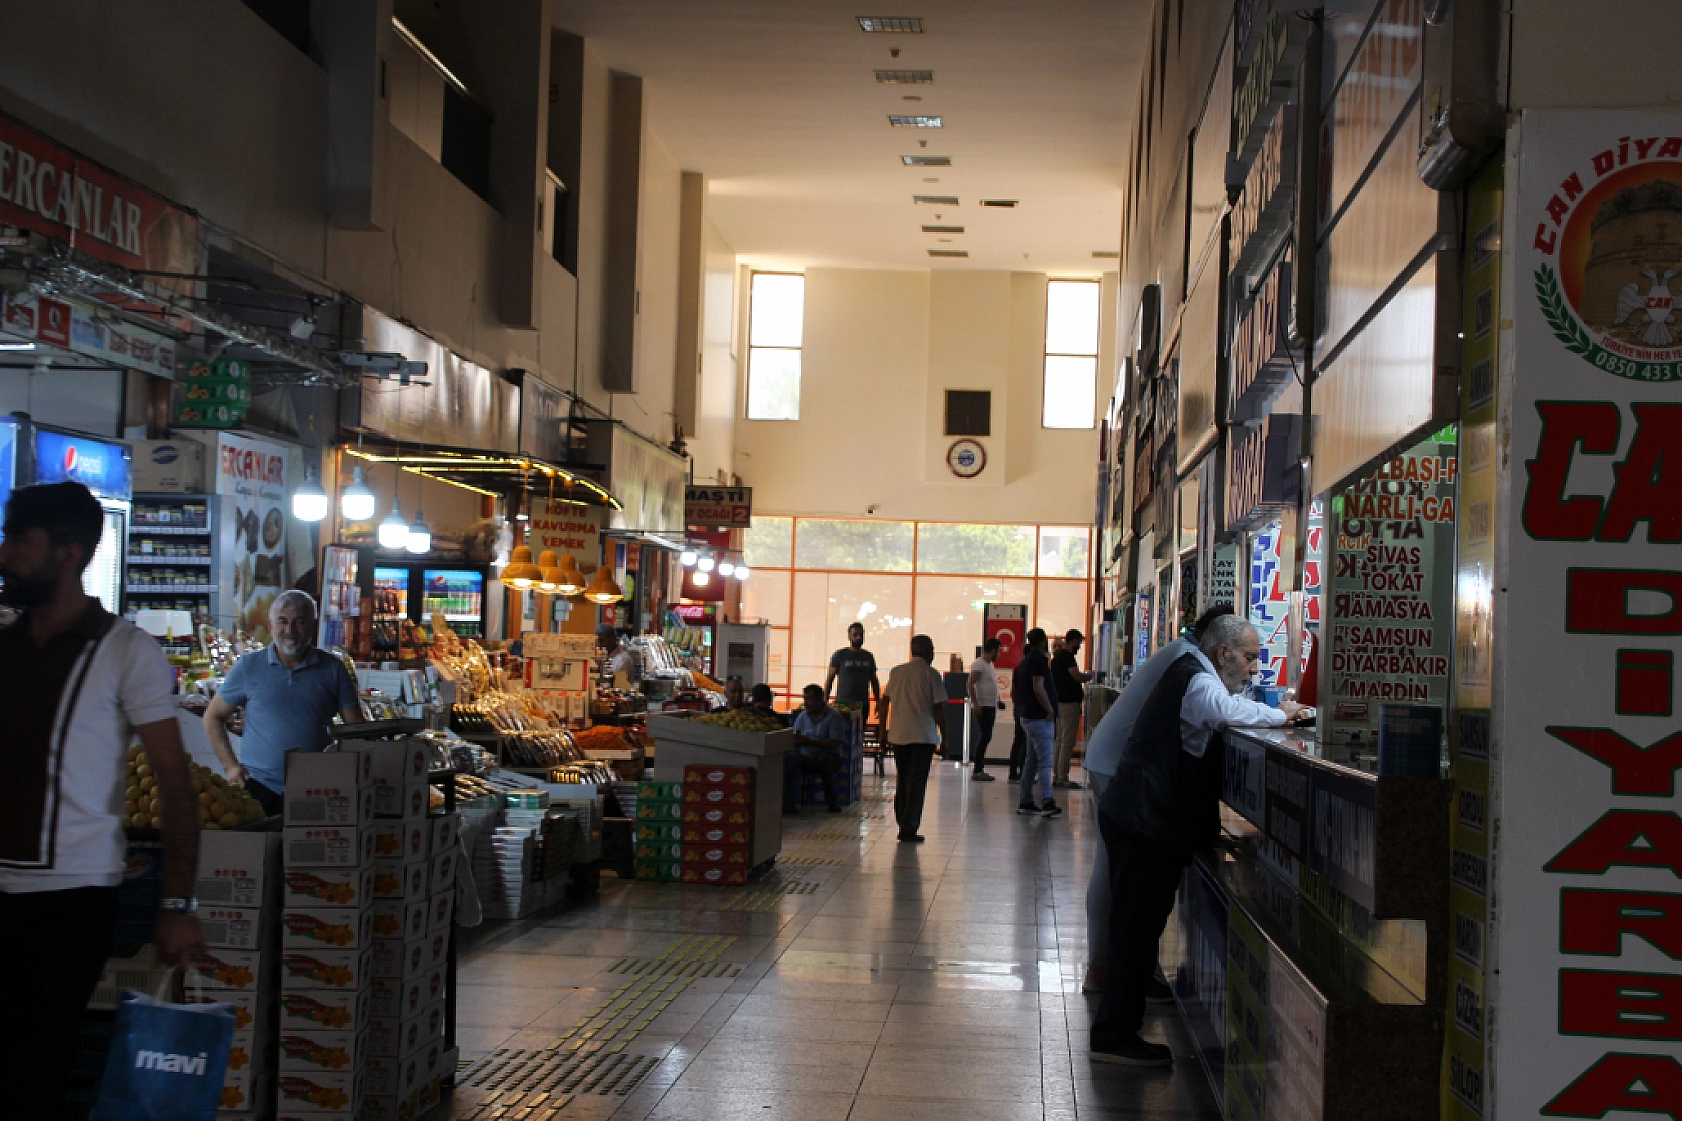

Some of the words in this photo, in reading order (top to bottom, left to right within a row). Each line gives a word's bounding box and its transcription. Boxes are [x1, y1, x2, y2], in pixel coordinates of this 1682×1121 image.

[1533, 171, 1584, 256] CAN
[1646, 297, 1672, 309] CAN
[1595, 351, 1636, 378] 0850
[1641, 363, 1671, 380] 433
[1653, 350, 1670, 361] HER
[221, 444, 284, 488] ERCANLAR
[545, 504, 588, 517] KÖFTE
[698, 507, 730, 520] OCAĞI
[734, 508, 748, 522] 2
[533, 519, 596, 535] KAVURMA
[542, 536, 586, 549] YEMEK
[1367, 540, 1421, 564] SİVAS
[1361, 572, 1425, 592] TOKAT
[1350, 598, 1433, 620] AMASYA
[1350, 625, 1433, 648] SAMSUN
[1332, 649, 1447, 676] DİYARBAKIR
[1349, 678, 1429, 702] MARDİN
[1459, 790, 1483, 826] ORDU
[134, 1049, 208, 1076] mavi
